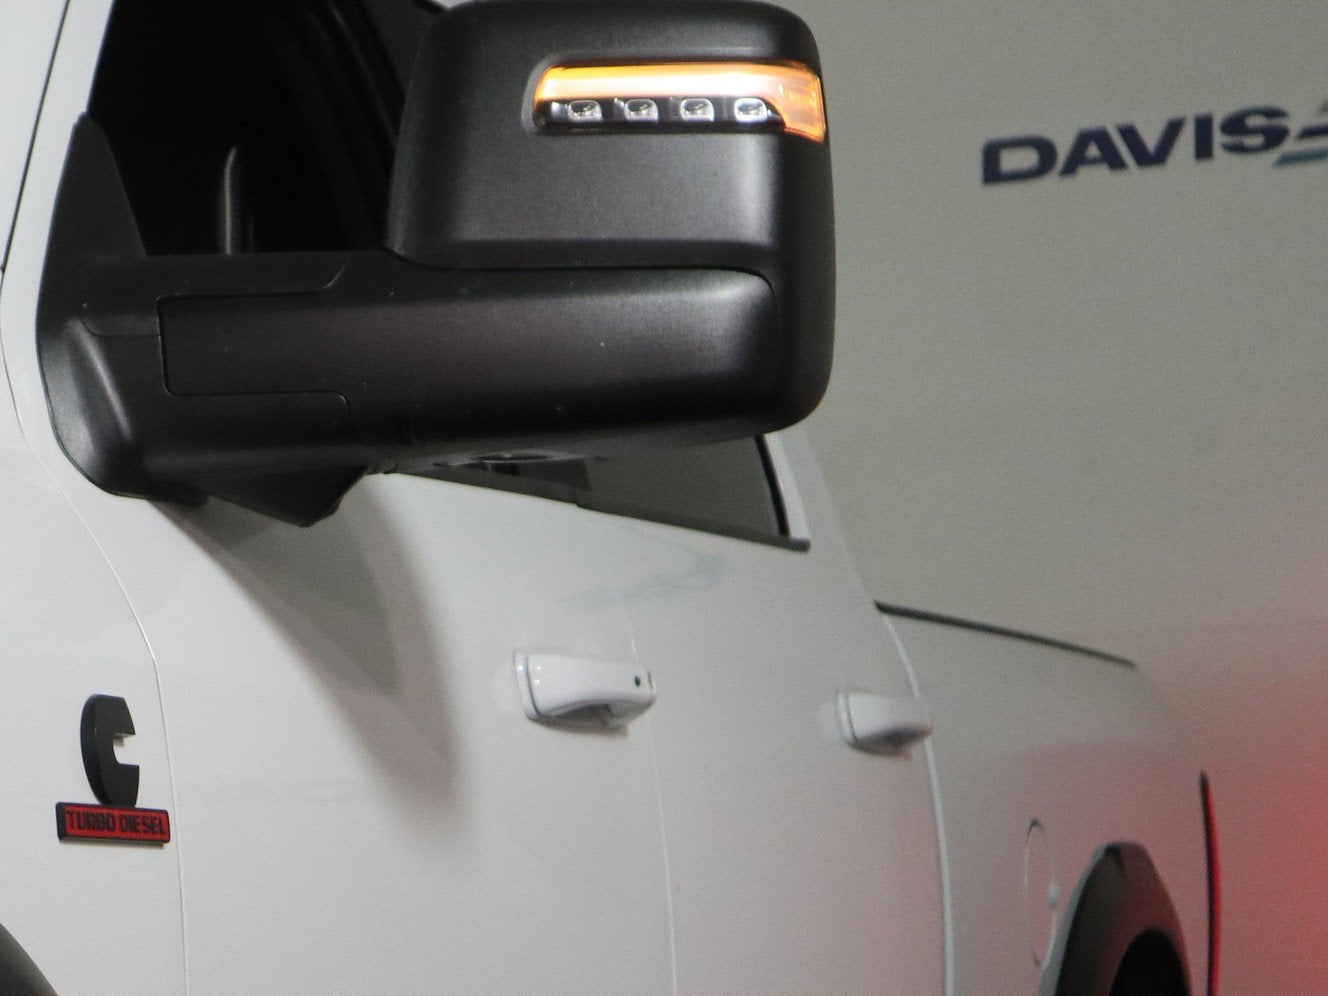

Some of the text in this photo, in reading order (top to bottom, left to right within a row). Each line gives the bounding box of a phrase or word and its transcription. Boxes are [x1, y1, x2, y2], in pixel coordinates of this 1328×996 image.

[982, 106, 1290, 185] DAVIS
[66, 811, 166, 835] TURBO DIESEL
